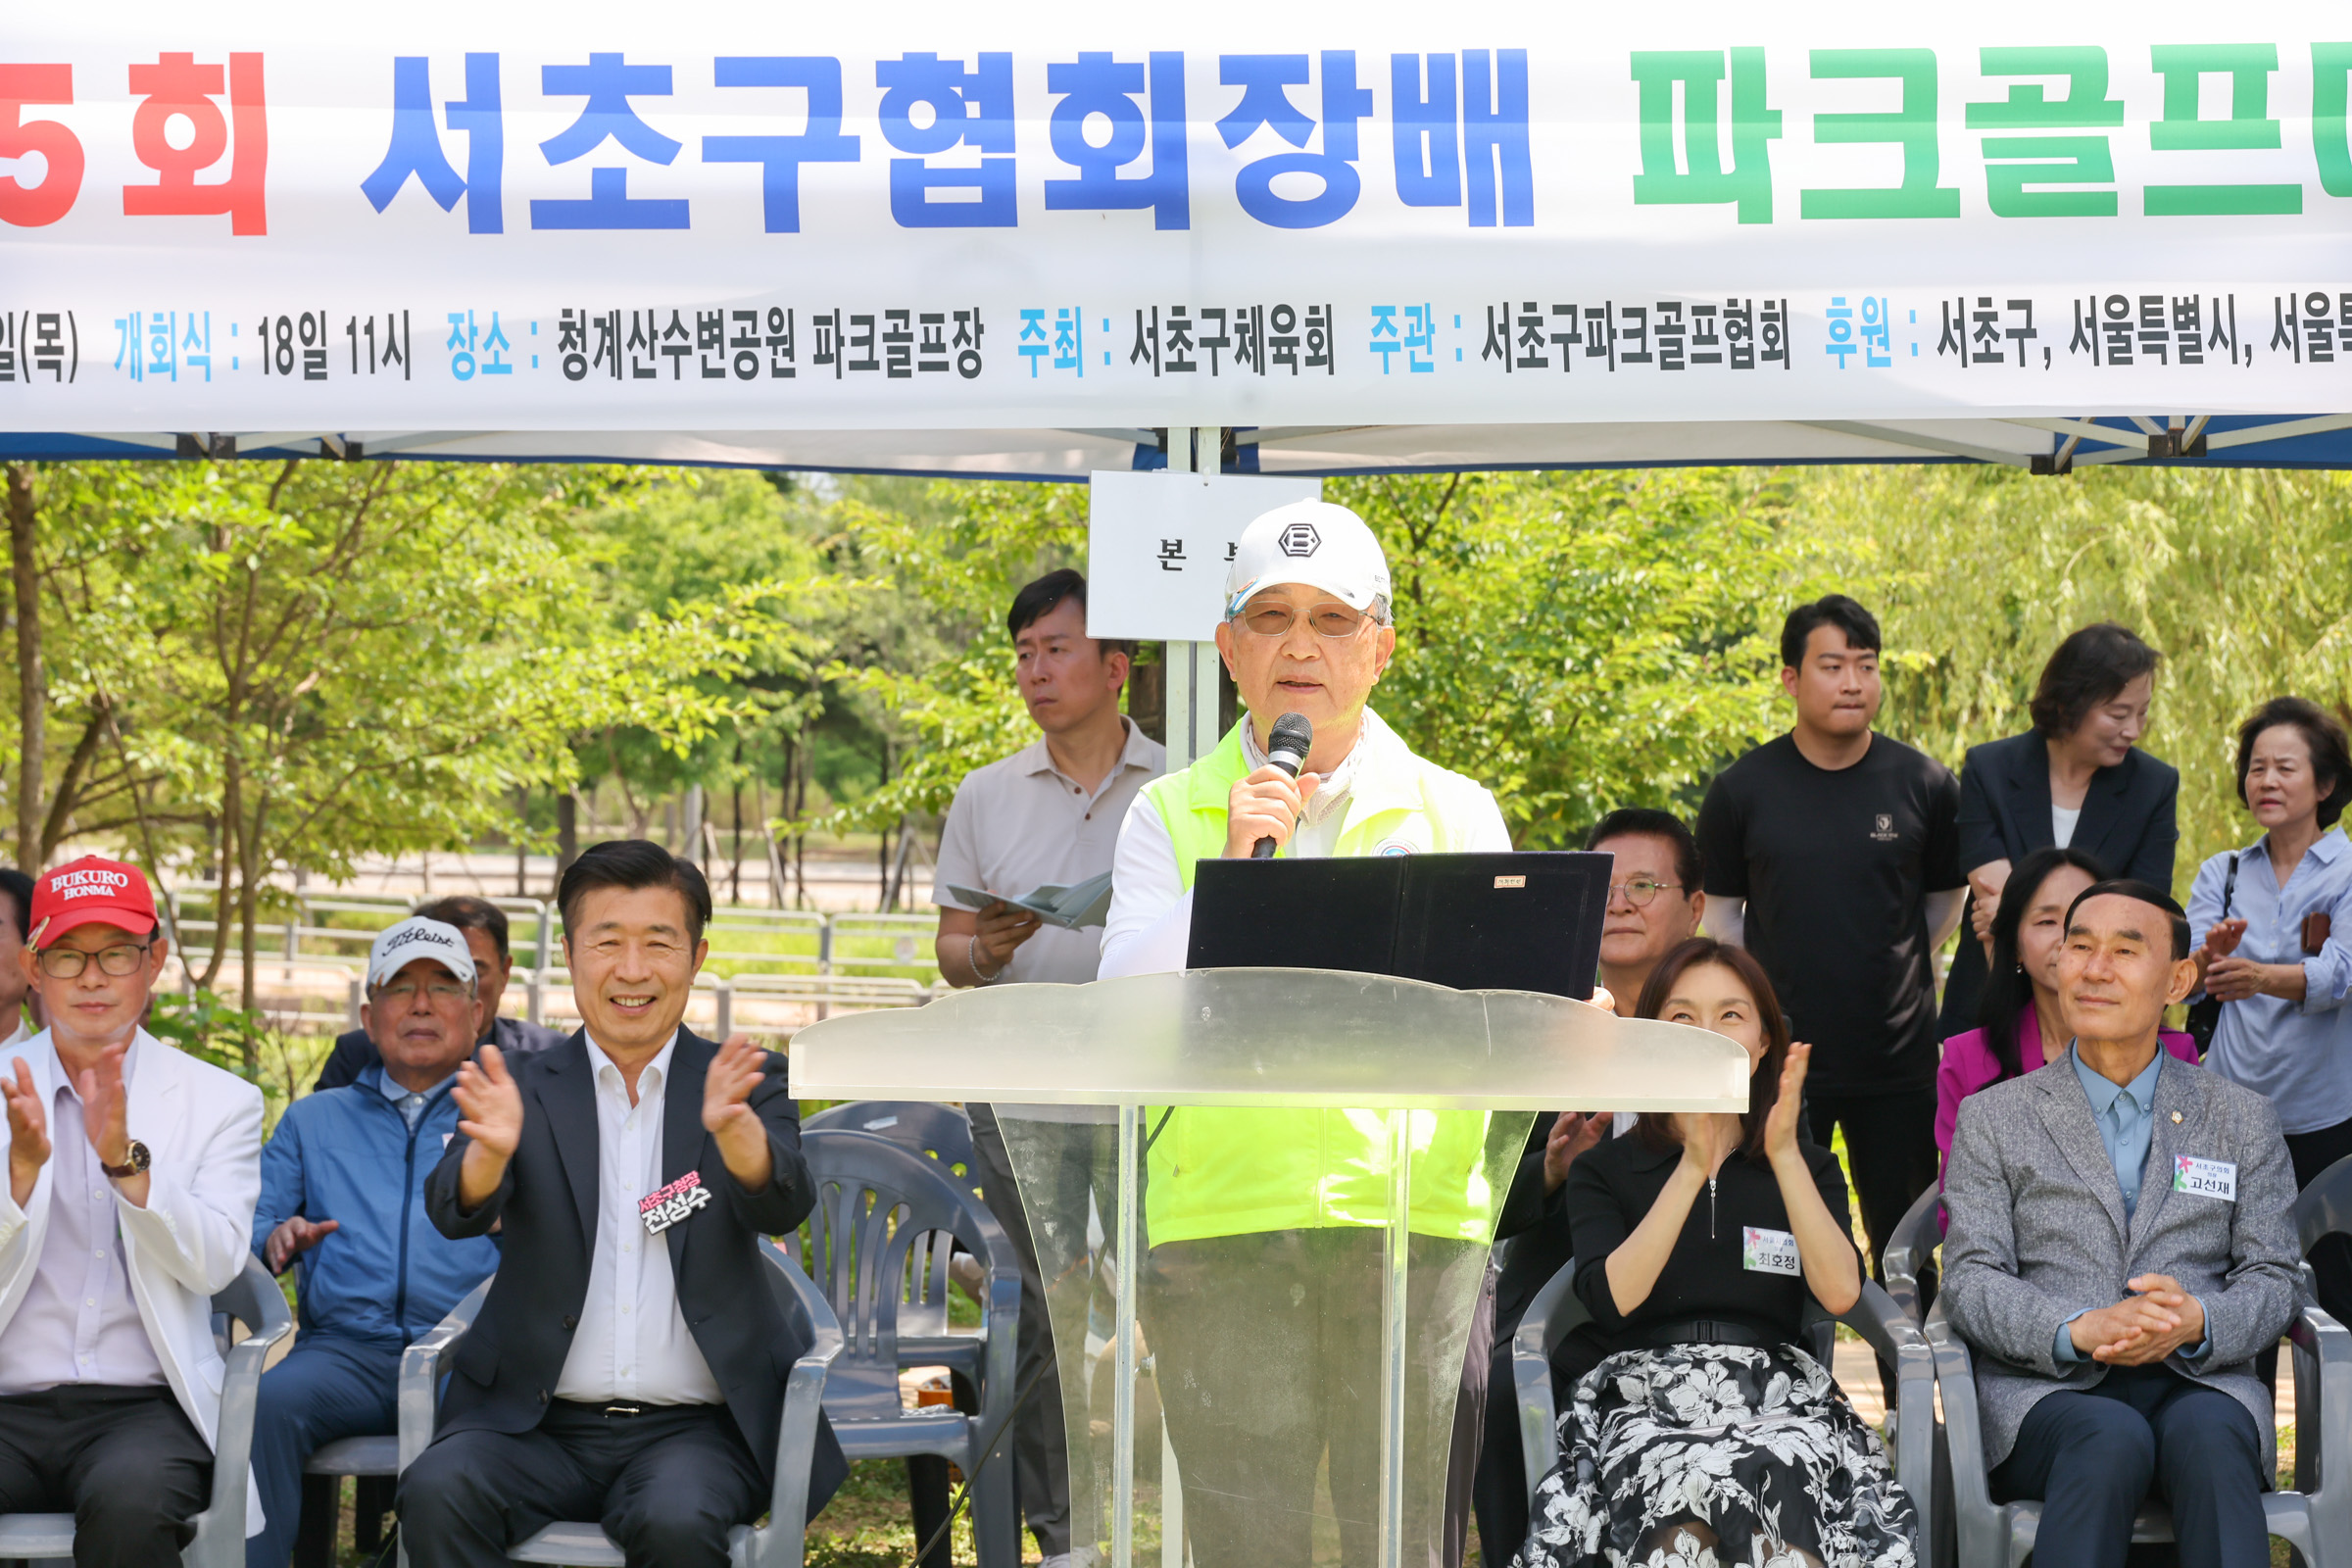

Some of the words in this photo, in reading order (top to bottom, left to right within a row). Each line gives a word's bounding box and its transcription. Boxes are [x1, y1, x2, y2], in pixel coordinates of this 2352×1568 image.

[0, 52, 268, 236] 5회
[361, 49, 1534, 234] 서초구협회장배
[1631, 42, 2352, 223] 파크골프
[115, 312, 211, 382] 개회식
[259, 311, 327, 380] 18일
[347, 310, 410, 380] 11시
[447, 310, 512, 381] 장소
[558, 307, 796, 381] 청계산수변공원
[813, 307, 984, 379] 파크골프장
[1018, 307, 1083, 377] 주최
[1130, 304, 1334, 377] 서초구체육회
[1370, 303, 1435, 374] 주관
[1482, 299, 1789, 373] 서초구파크골프협회
[1826, 297, 1891, 368] 후원
[1937, 297, 2050, 370] 서초구,
[2070, 294, 2252, 368] 서울특별시,
[1156, 539, 1187, 571] 본
[50, 870, 128, 893] BUKURO
[63, 885, 116, 901] HONMA
[381, 926, 455, 956] Titleist
[638, 1170, 701, 1213] 서초구청장
[2190, 1176, 2230, 1195] 고선재
[641, 1186, 712, 1236] 전성수
[1759, 1252, 1795, 1270] 최호정
